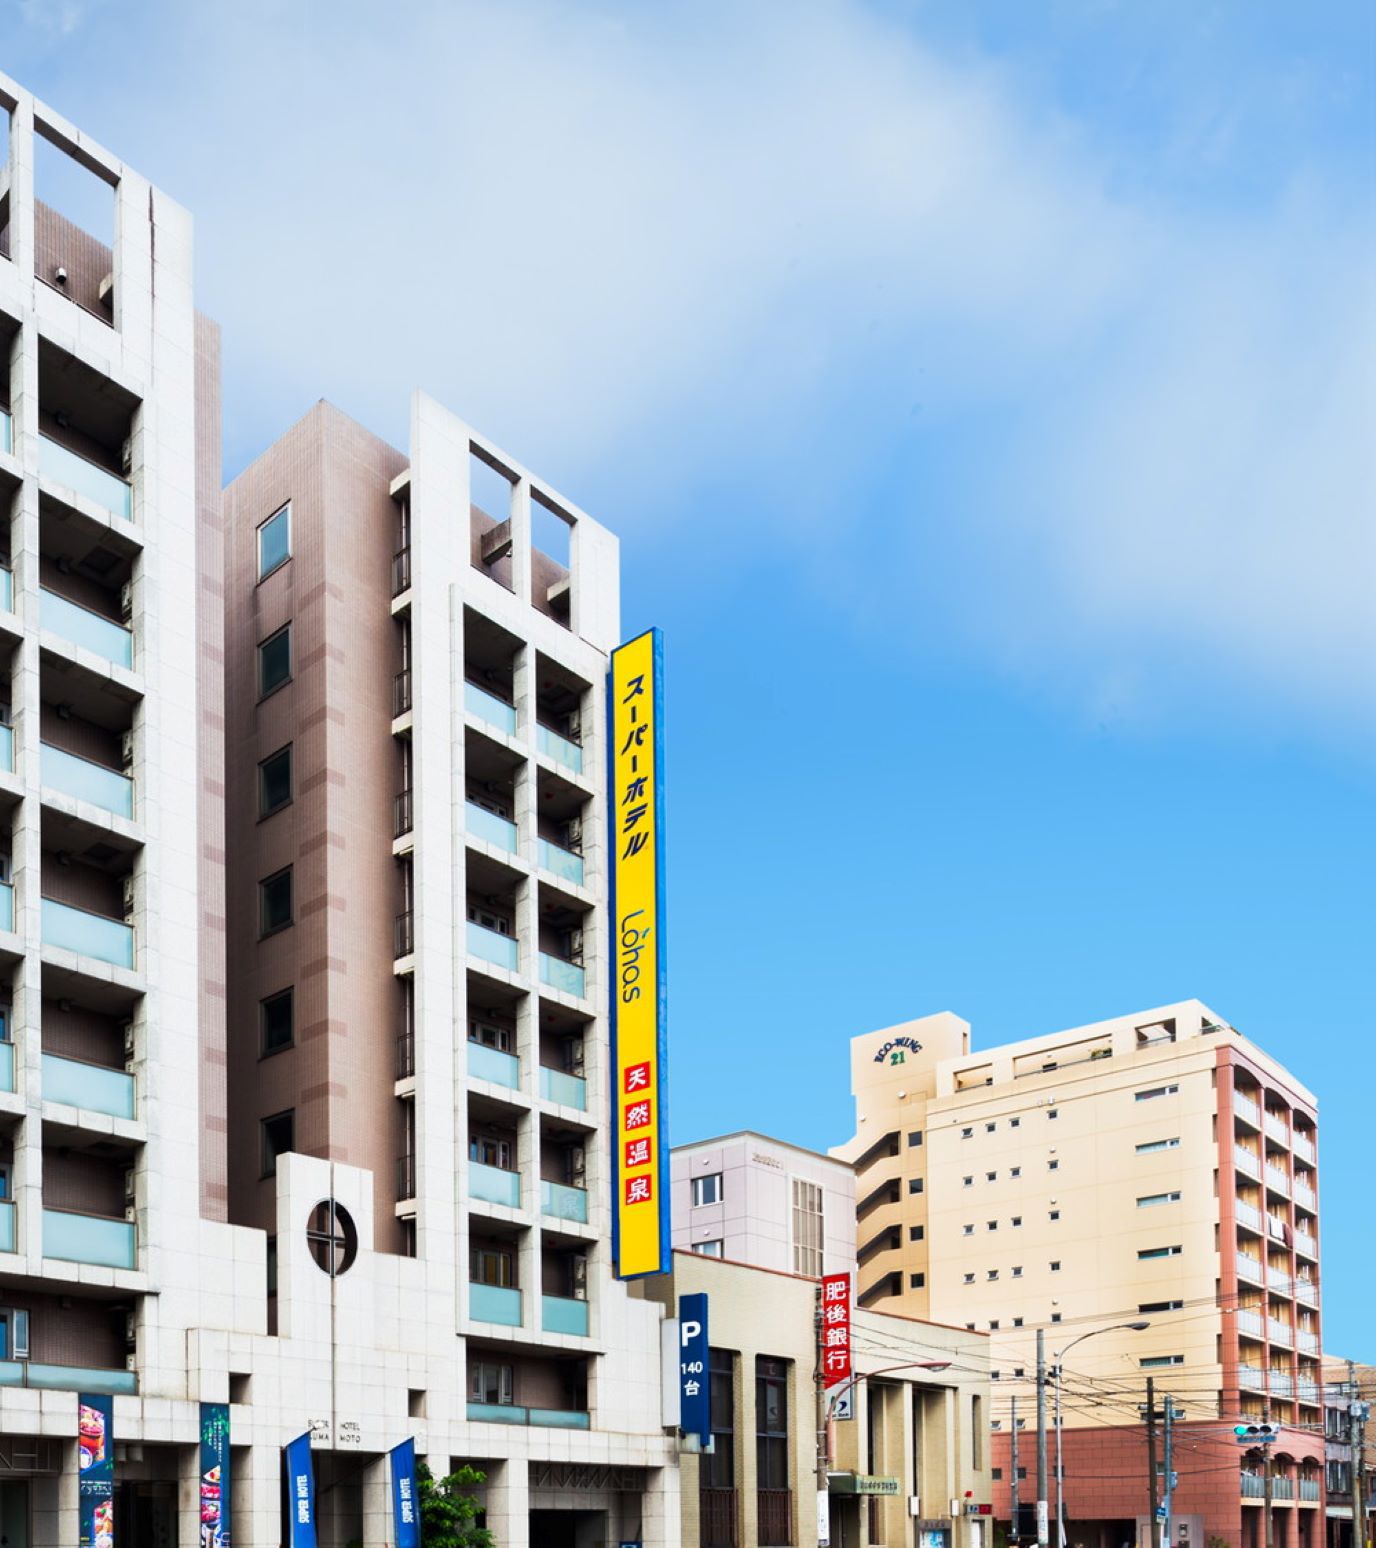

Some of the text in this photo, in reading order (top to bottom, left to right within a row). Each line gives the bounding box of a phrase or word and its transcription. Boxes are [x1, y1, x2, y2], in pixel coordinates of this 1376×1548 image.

[621, 673, 649, 861] スーパーホテル
[874, 1037, 923, 1063] ECO-WING
[890, 1051, 905, 1066] 21
[627, 1066, 650, 1203] 天然温泉
[681, 1320, 701, 1347] P
[826, 1280, 848, 1371] 肥後銀行
[681, 1361, 703, 1375] 140
[684, 1379, 700, 1396] 台
[310, 1432, 330, 1441] UMA
[296, 1474, 310, 1524] SUPER HOTEL
[399, 1477, 414, 1524] SUPER HOTEL
